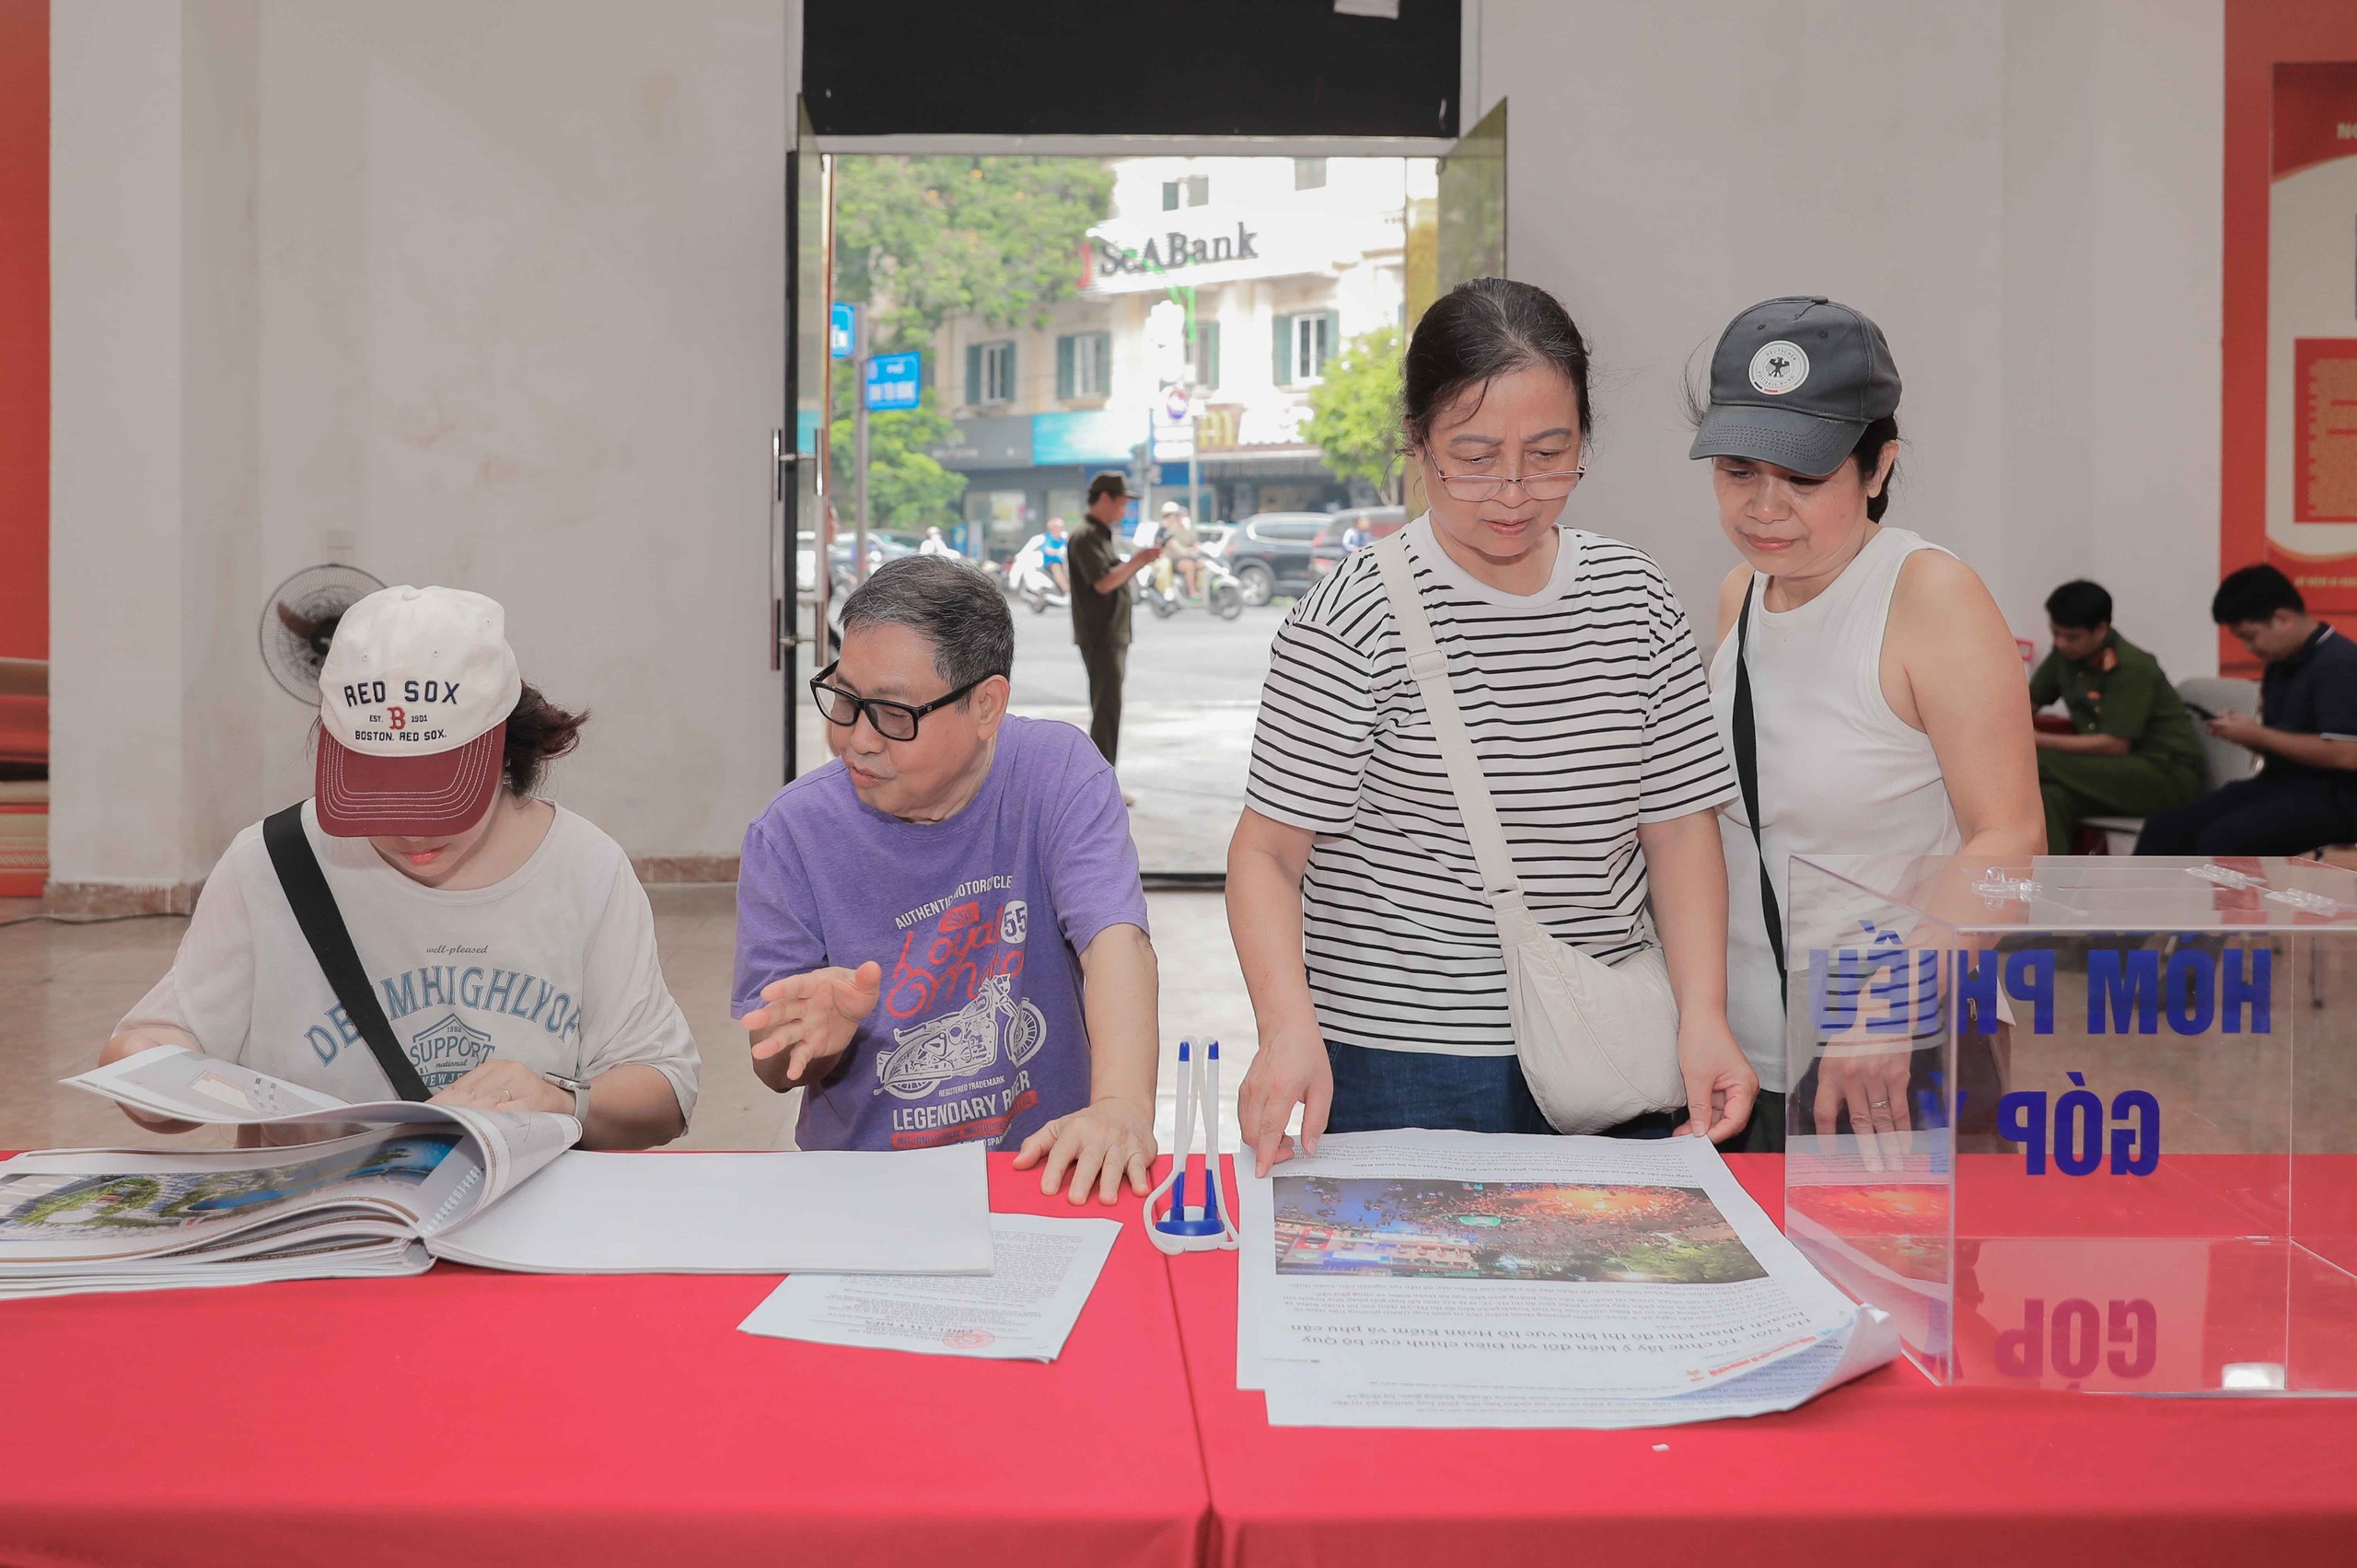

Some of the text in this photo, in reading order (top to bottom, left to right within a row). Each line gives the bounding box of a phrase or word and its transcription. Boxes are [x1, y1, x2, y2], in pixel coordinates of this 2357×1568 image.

[1101, 221, 1260, 276] SeABank
[343, 680, 460, 707] RED SOX
[369, 706, 428, 730] EST. B 1901
[399, 732, 420, 741] RED
[1004, 906, 1027, 937] 55
[426, 945, 489, 956] well-pleased
[410, 1036, 496, 1067] SUPPORT
[435, 1059, 469, 1068] national
[969, 1075, 1005, 1090] TRADEMARK
[893, 1094, 996, 1132] LEGENDARY
[1301, 1335, 1338, 1345] Quy
[1562, 1332, 1596, 1341] khu
